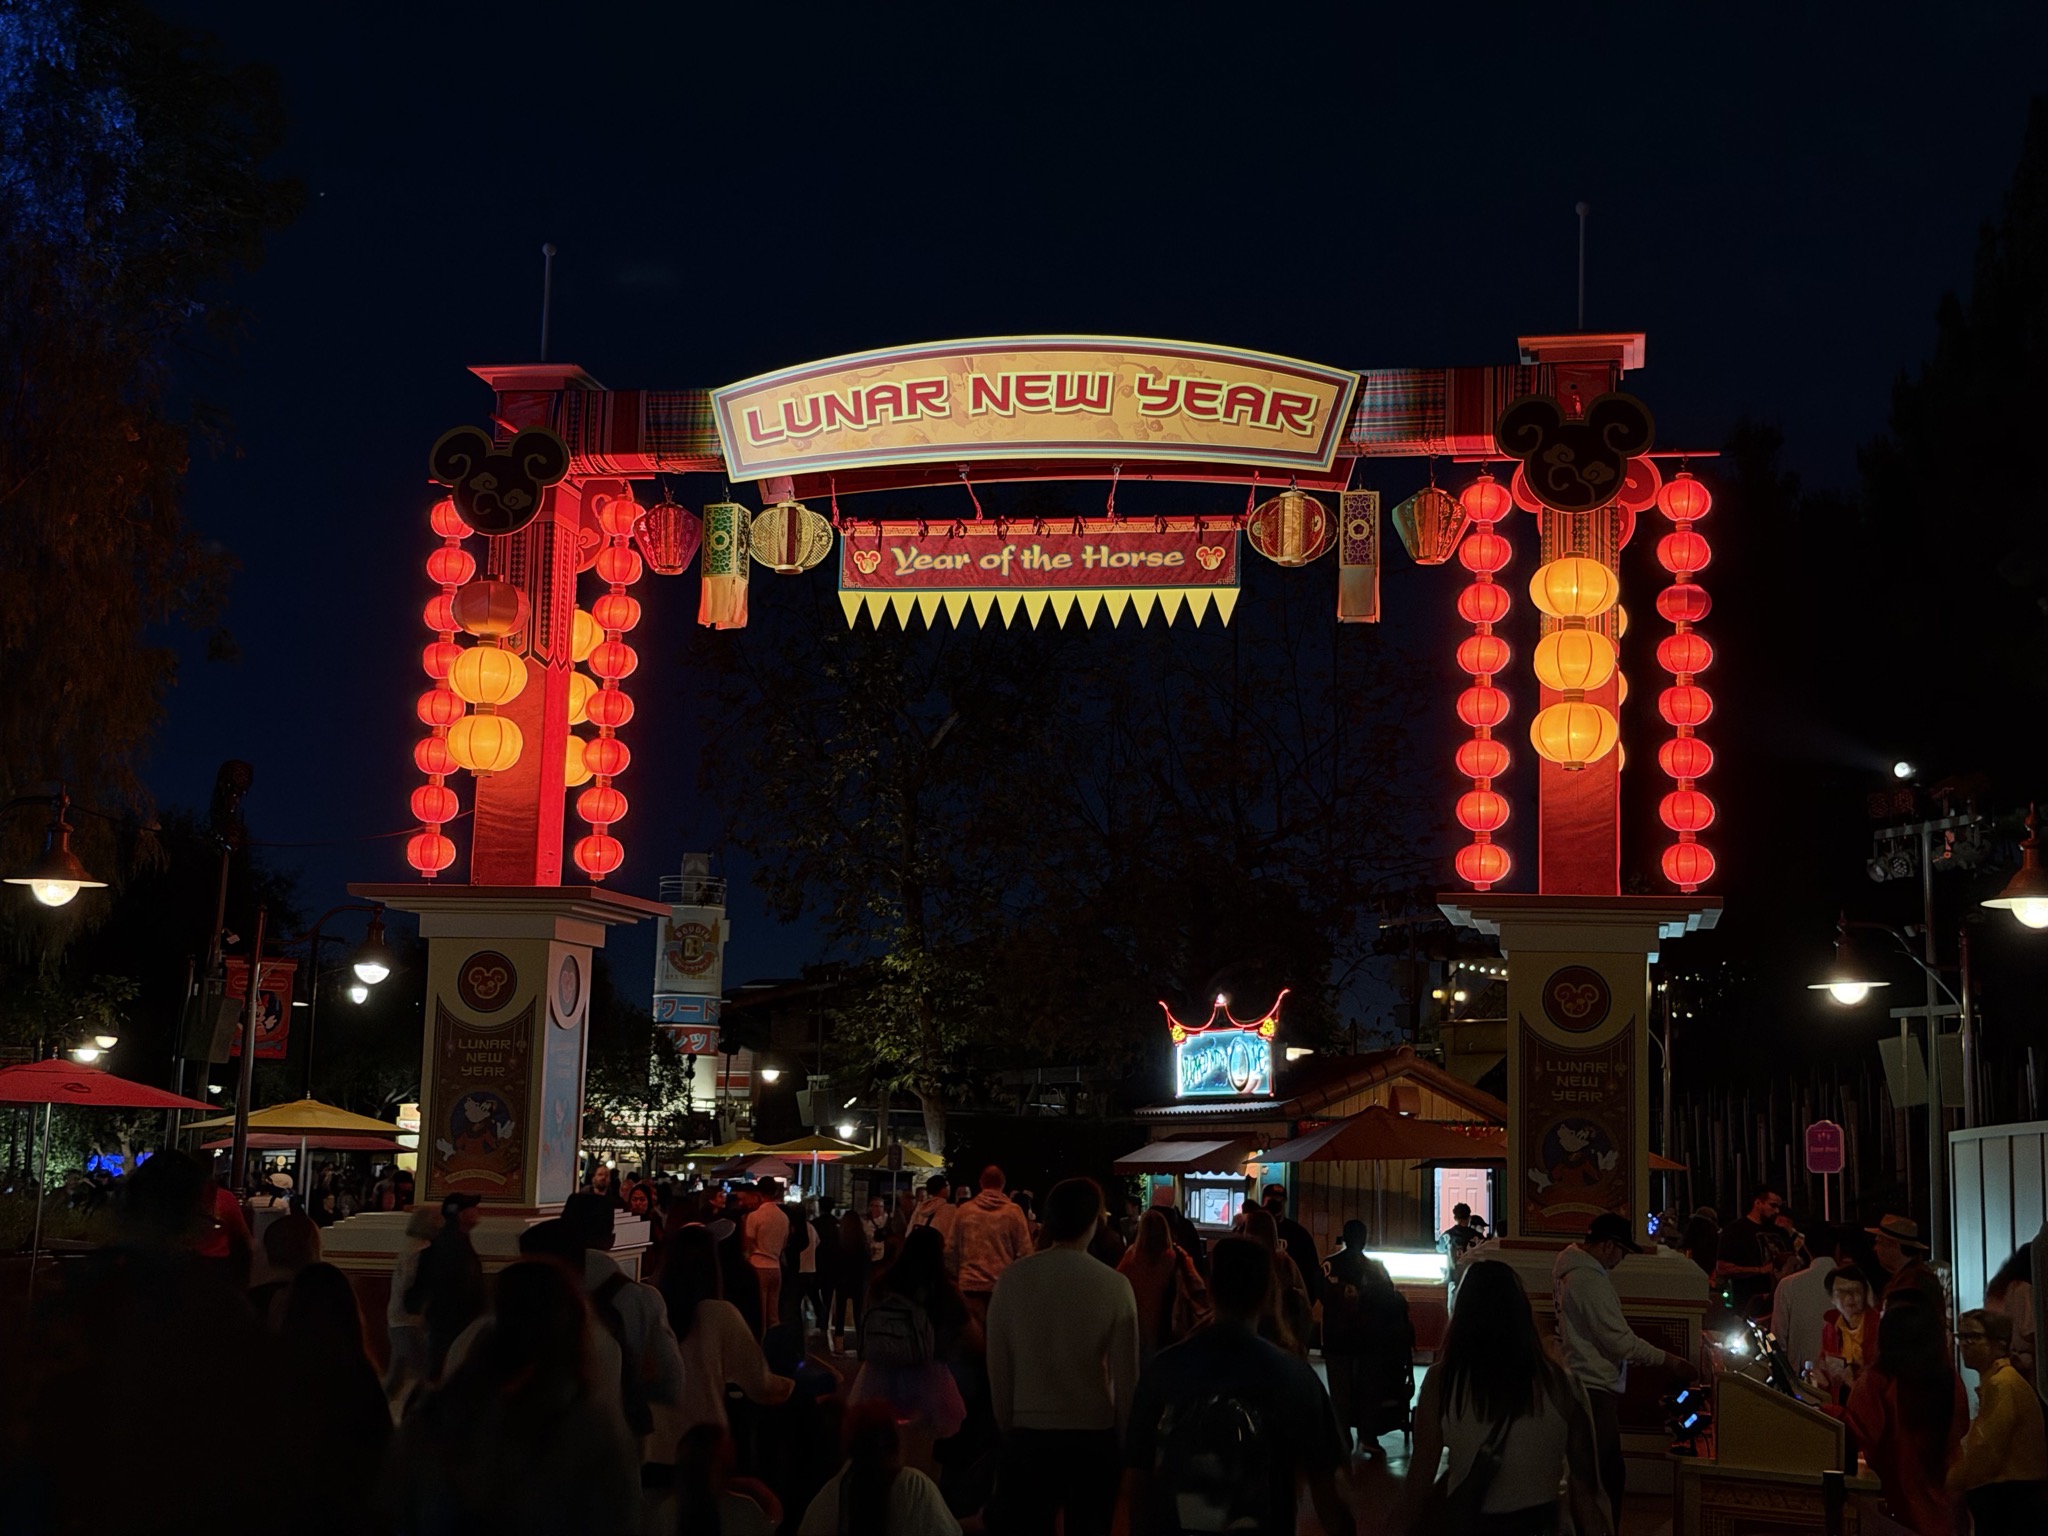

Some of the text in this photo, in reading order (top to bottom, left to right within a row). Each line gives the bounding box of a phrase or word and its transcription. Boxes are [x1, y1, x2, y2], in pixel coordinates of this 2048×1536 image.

[743, 371, 1318, 447] LUNAR NEW YEAR
[890, 545, 1185, 577] Year of the Horse
[458, 1039, 511, 1051] LUNAR
[466, 1052, 502, 1063] NEW
[461, 1066, 505, 1077] YEAR
[1546, 1060, 1608, 1073] LUNAR
[1556, 1075, 1598, 1088] NEW
[1552, 1090, 1603, 1103] YEAR
